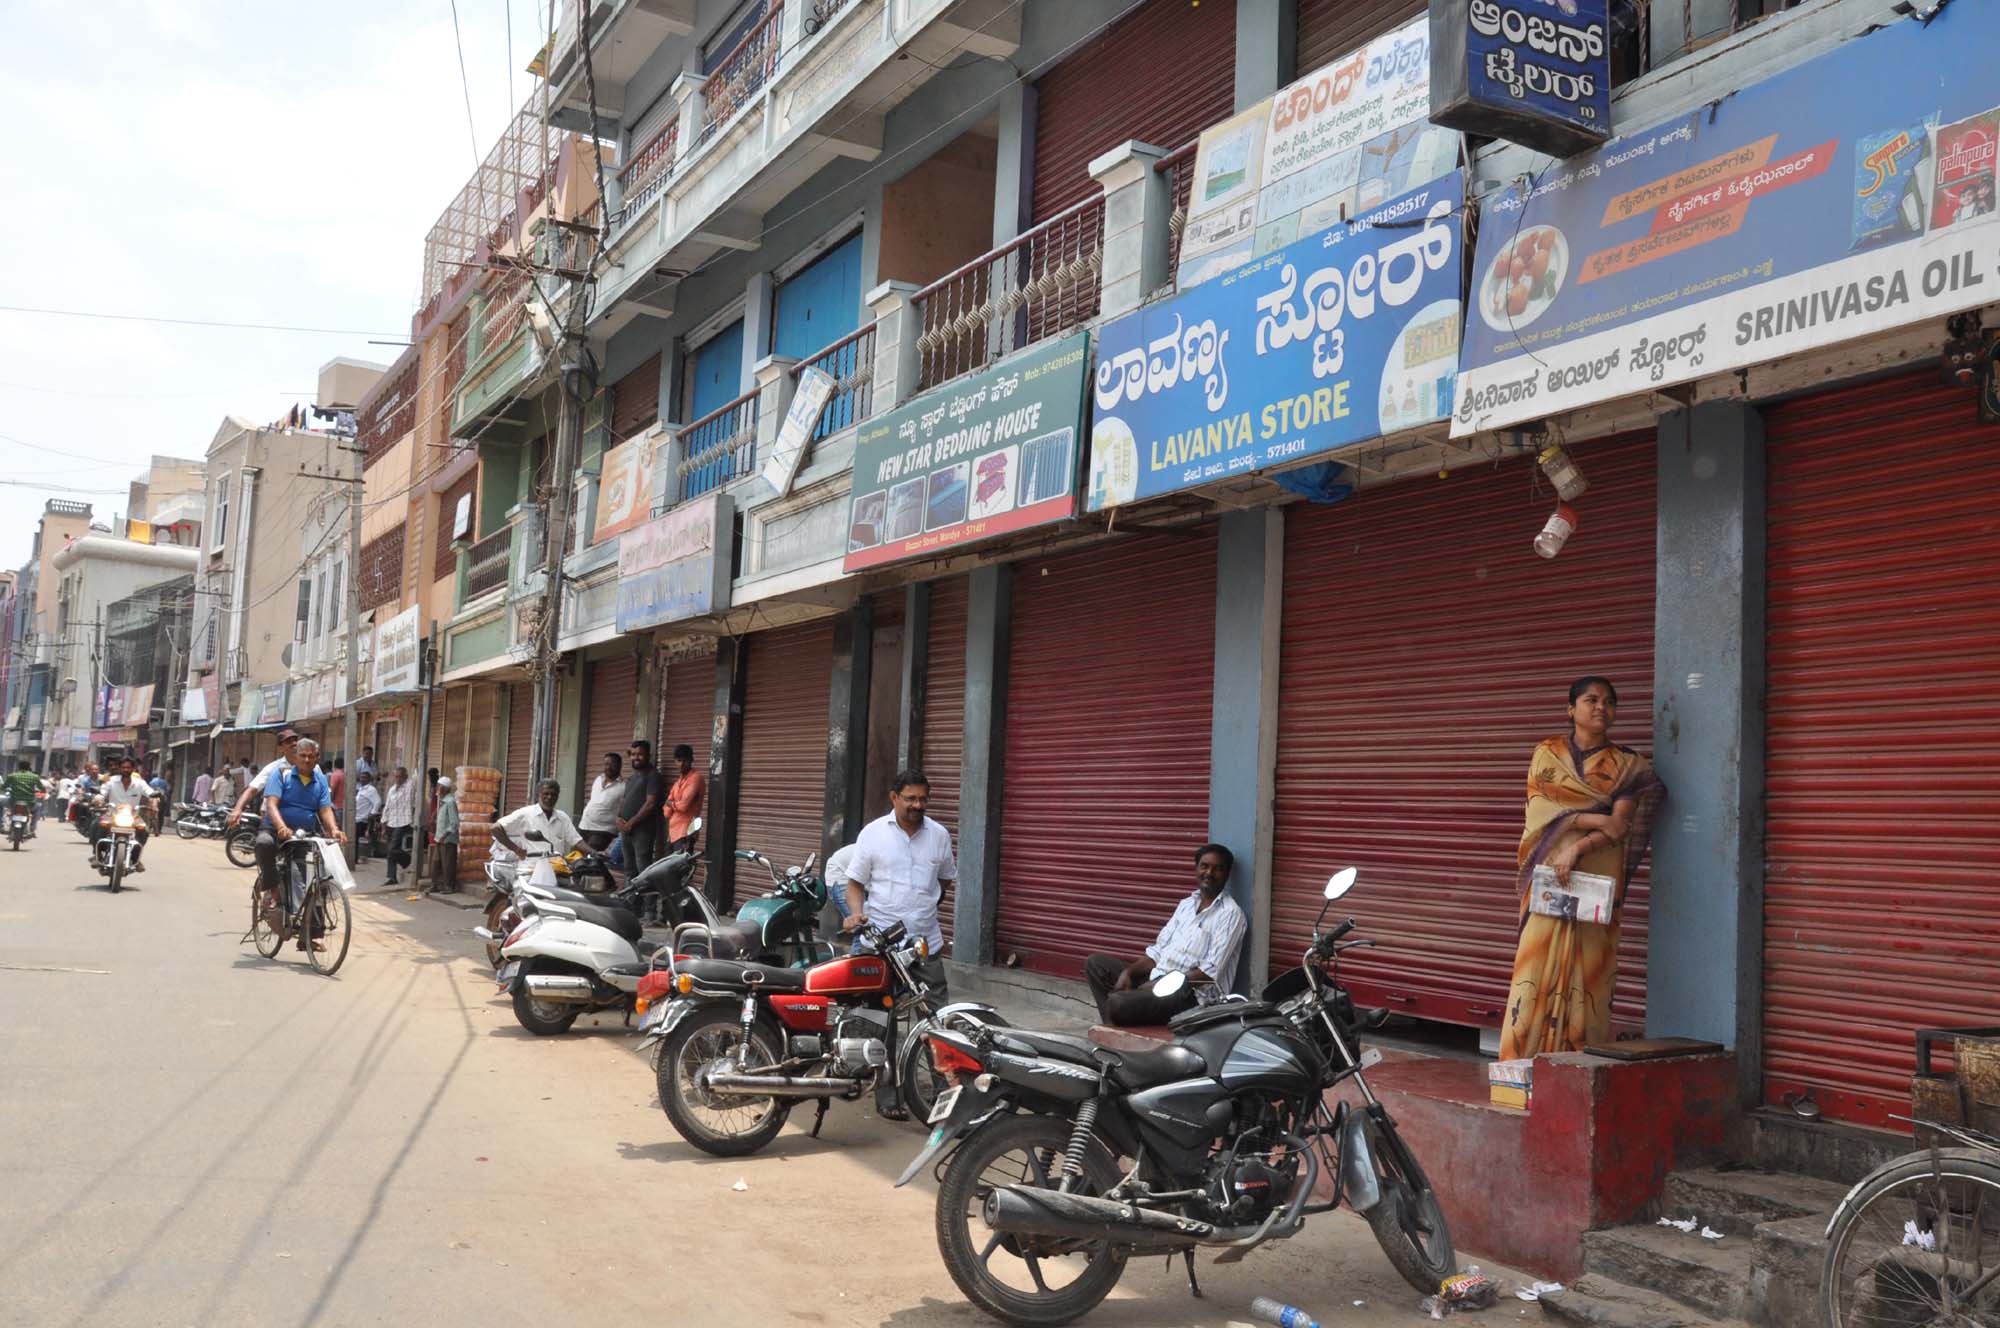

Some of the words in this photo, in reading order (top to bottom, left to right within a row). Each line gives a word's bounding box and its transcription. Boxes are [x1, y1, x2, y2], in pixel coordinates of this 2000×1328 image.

[1096, 312, 1229, 412] ಲಾವಣ್ಯ
[1256, 200, 1452, 378] ಸ್ಟೋರ್
[1735, 269, 1909, 346] SRINIVASA
[1922, 250, 1983, 298] OIL
[1151, 412, 1253, 472] LAVANYA
[1260, 380, 1350, 440] STORE
[1459, 369, 1539, 424] ಶ್ರೀನಿವಾಸ
[877, 457, 903, 484] NEW
[904, 443, 931, 475] STAR
[934, 420, 990, 463] BEDDING
[994, 402, 1042, 443] HOUSE
[1267, 438, 1306, 459] 571401
